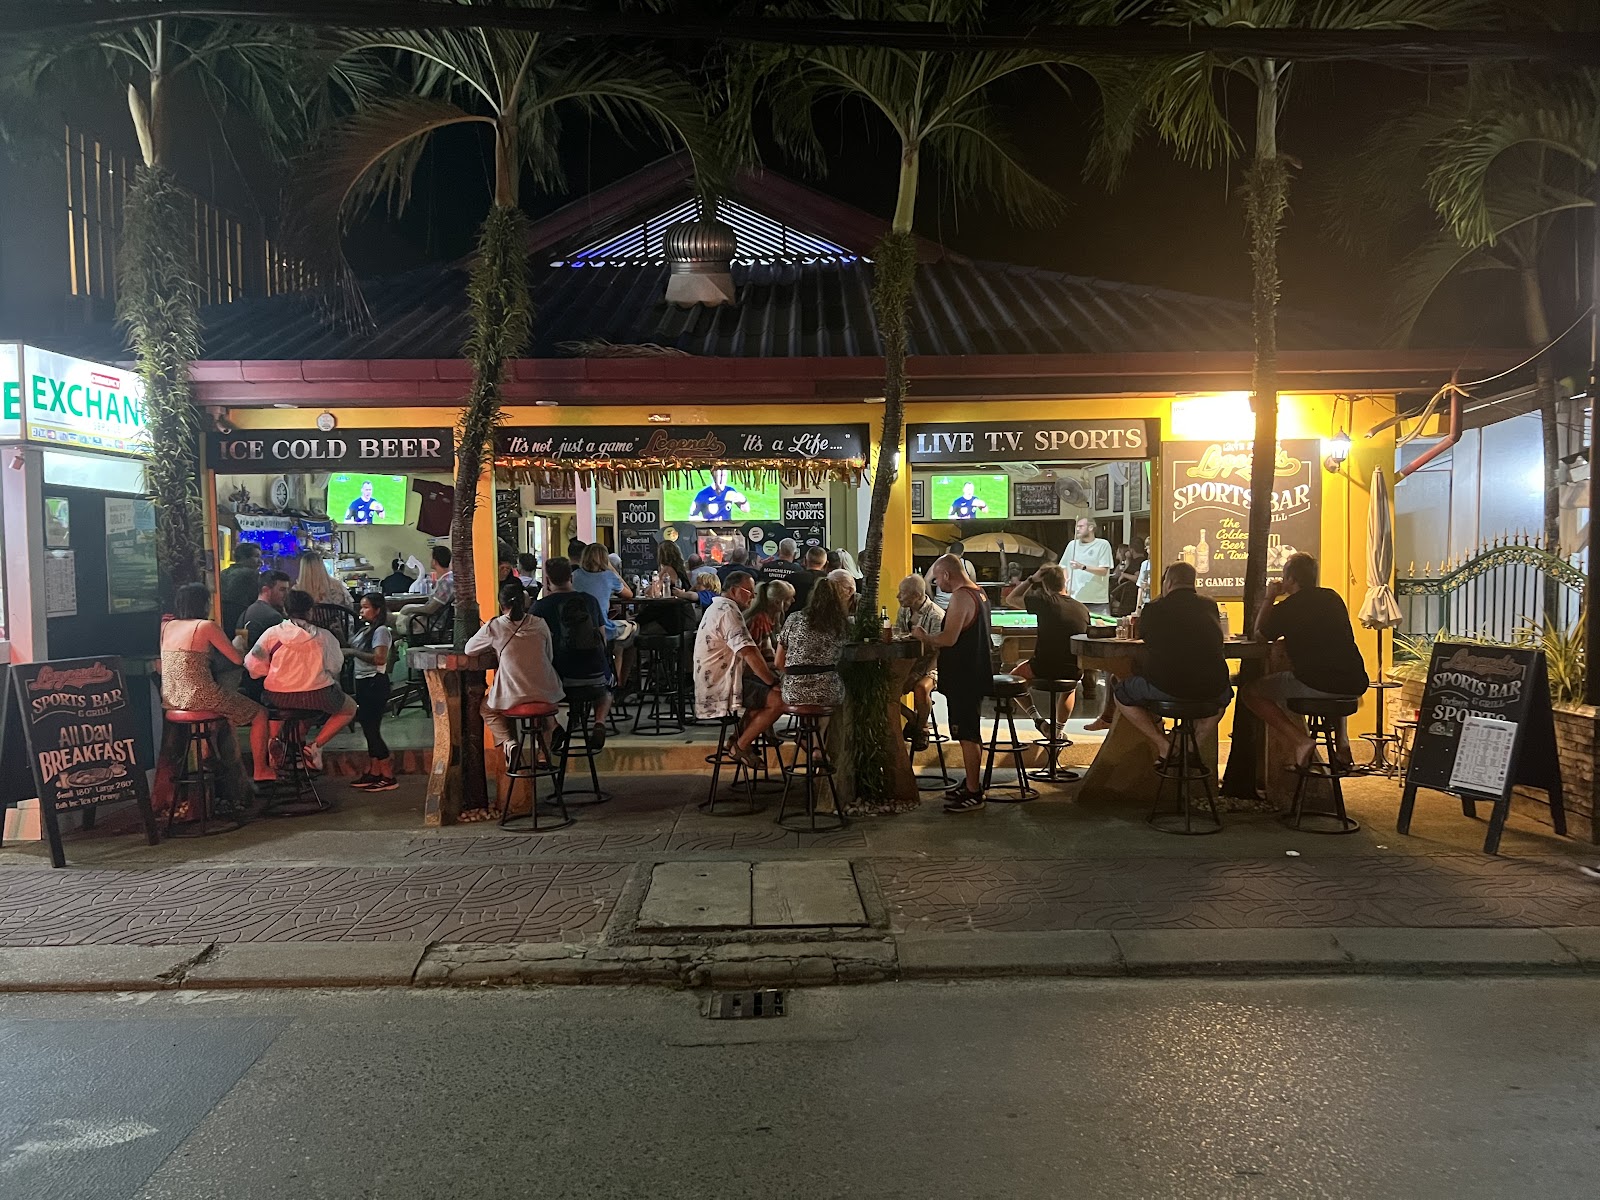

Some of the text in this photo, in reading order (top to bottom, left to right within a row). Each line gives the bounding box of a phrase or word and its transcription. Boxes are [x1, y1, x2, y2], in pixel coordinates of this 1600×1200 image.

[33, 375, 147, 427] EXCHAN
[638, 429, 726, 459] Legends
[772, 440, 784, 451] a
[917, 428, 1142, 453] LIVE T.V. SPORTS
[219, 438, 441, 460] ICE COLD BEER
[532, 438, 553, 452] not
[552, 438, 584, 459] just
[586, 442, 595, 451] a
[1173, 482, 1310, 512] SPORTS BAR
[629, 502, 647, 512] Good
[622, 512, 656, 523] FOOD
[786, 510, 824, 520] SPORTS
[1219, 517, 1240, 528] the
[1215, 529, 1250, 540] Coldes
[627, 537, 649, 545] Special
[1220, 540, 1245, 550] Beer
[622, 544, 650, 553] AUSSIE
[1213, 550, 1225, 560] in
[1205, 577, 1233, 587] GAME
[1235, 577, 1245, 587] IS
[1431, 672, 1521, 698] SPORTS BAR
[32, 689, 124, 713] SPORTS BAR
[1479, 699, 1506, 708] GRILL
[86, 707, 111, 717] GRILL
[59, 723, 113, 747] All Day
[39, 739, 136, 784] BREAKFAST
